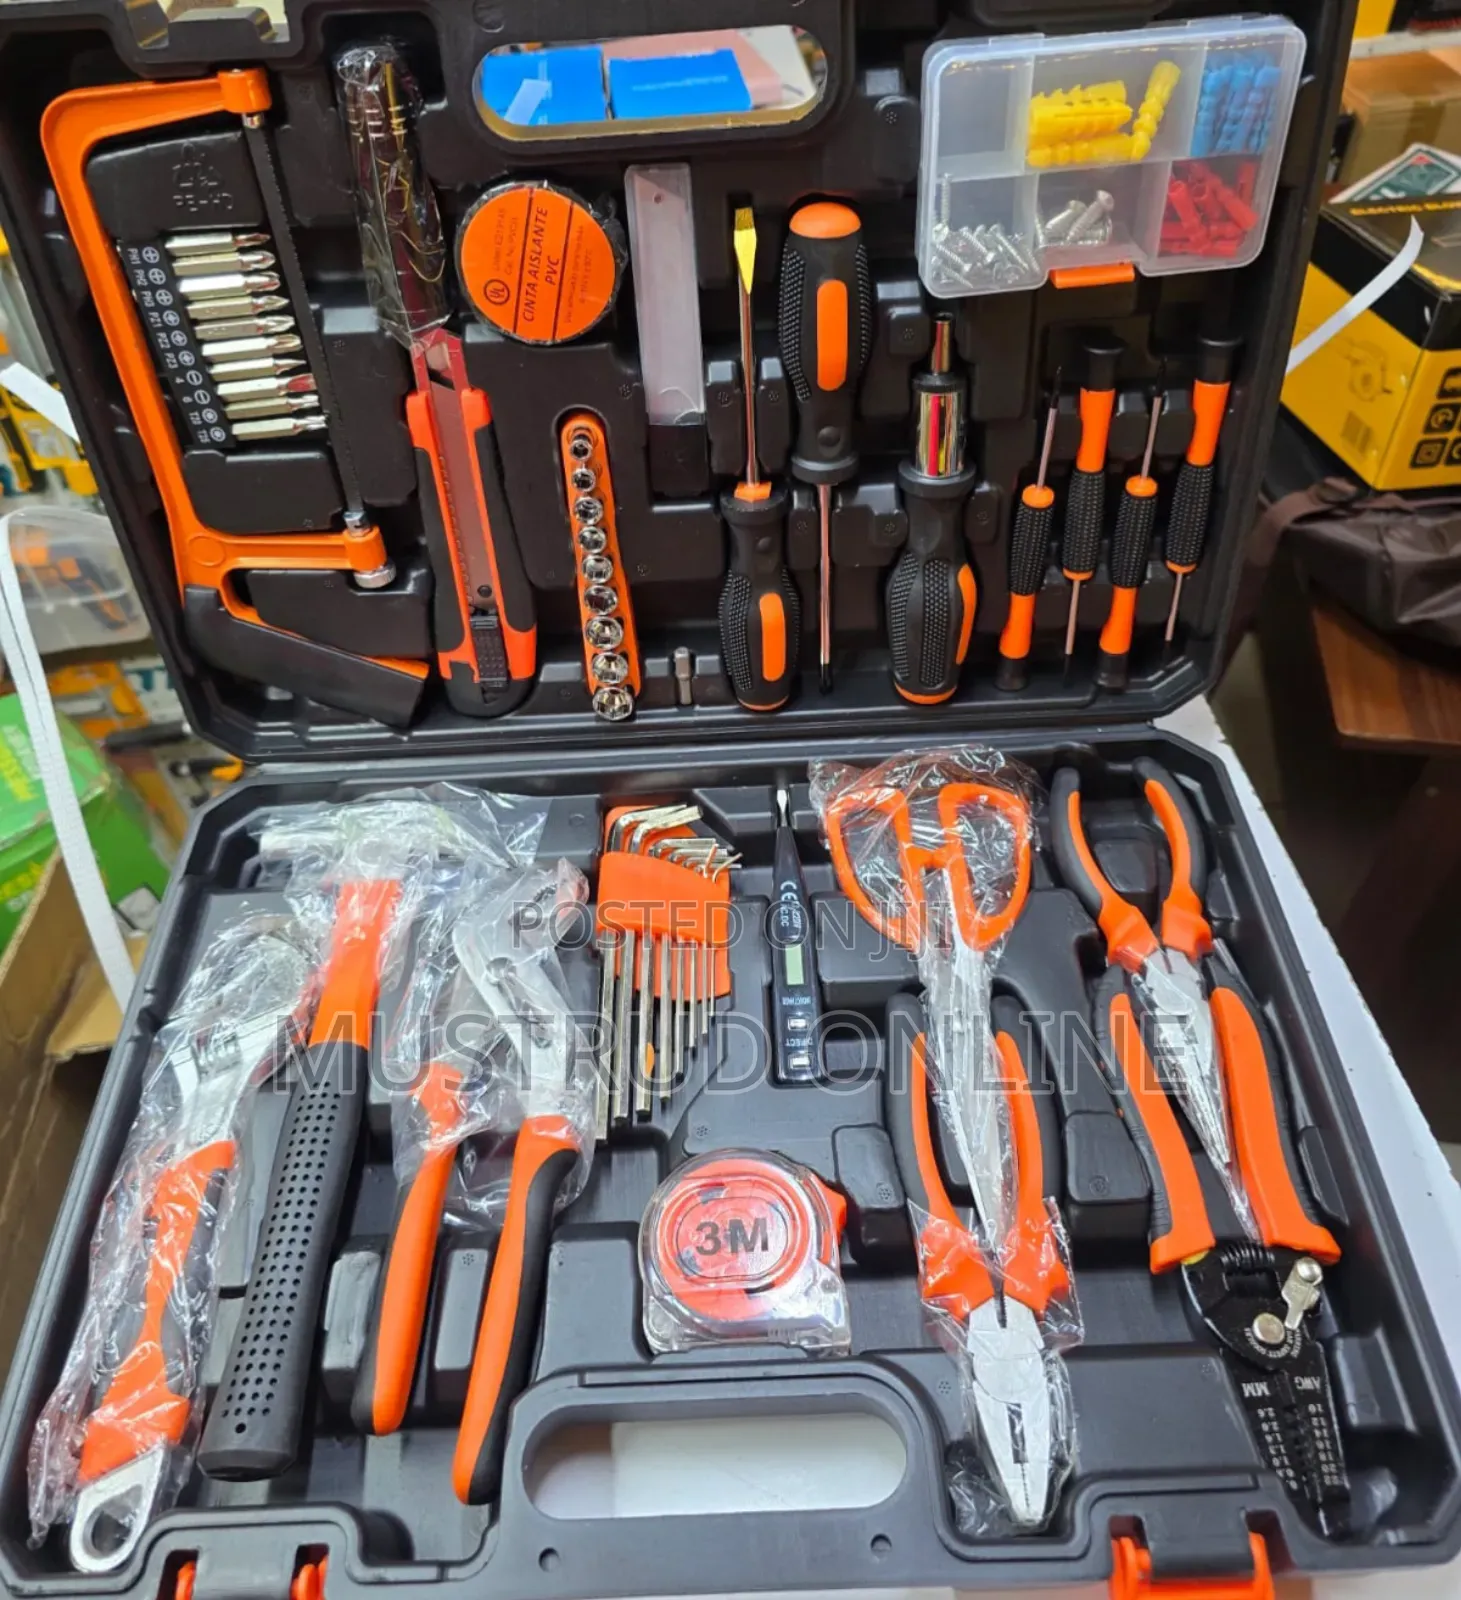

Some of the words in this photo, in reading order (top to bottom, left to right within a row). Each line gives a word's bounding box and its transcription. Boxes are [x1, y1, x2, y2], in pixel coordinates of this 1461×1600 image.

[528, 206, 548, 280] AISLANTE
[127, 247, 141, 265] PH1
[133, 269, 149, 286] PH2
[545, 255, 560, 286] PVC
[140, 290, 155, 308] PH3
[523, 282, 538, 322] CINTA
[148, 311, 163, 328] PZ1
[155, 332, 171, 349] PZ2
[163, 352, 179, 370] PZ3
[695, 1217, 769, 1256] 3M
[1241, 1381, 1271, 1398] MM
[1294, 1376, 1321, 1391] AWG
[1311, 1416, 1327, 1427] 12
